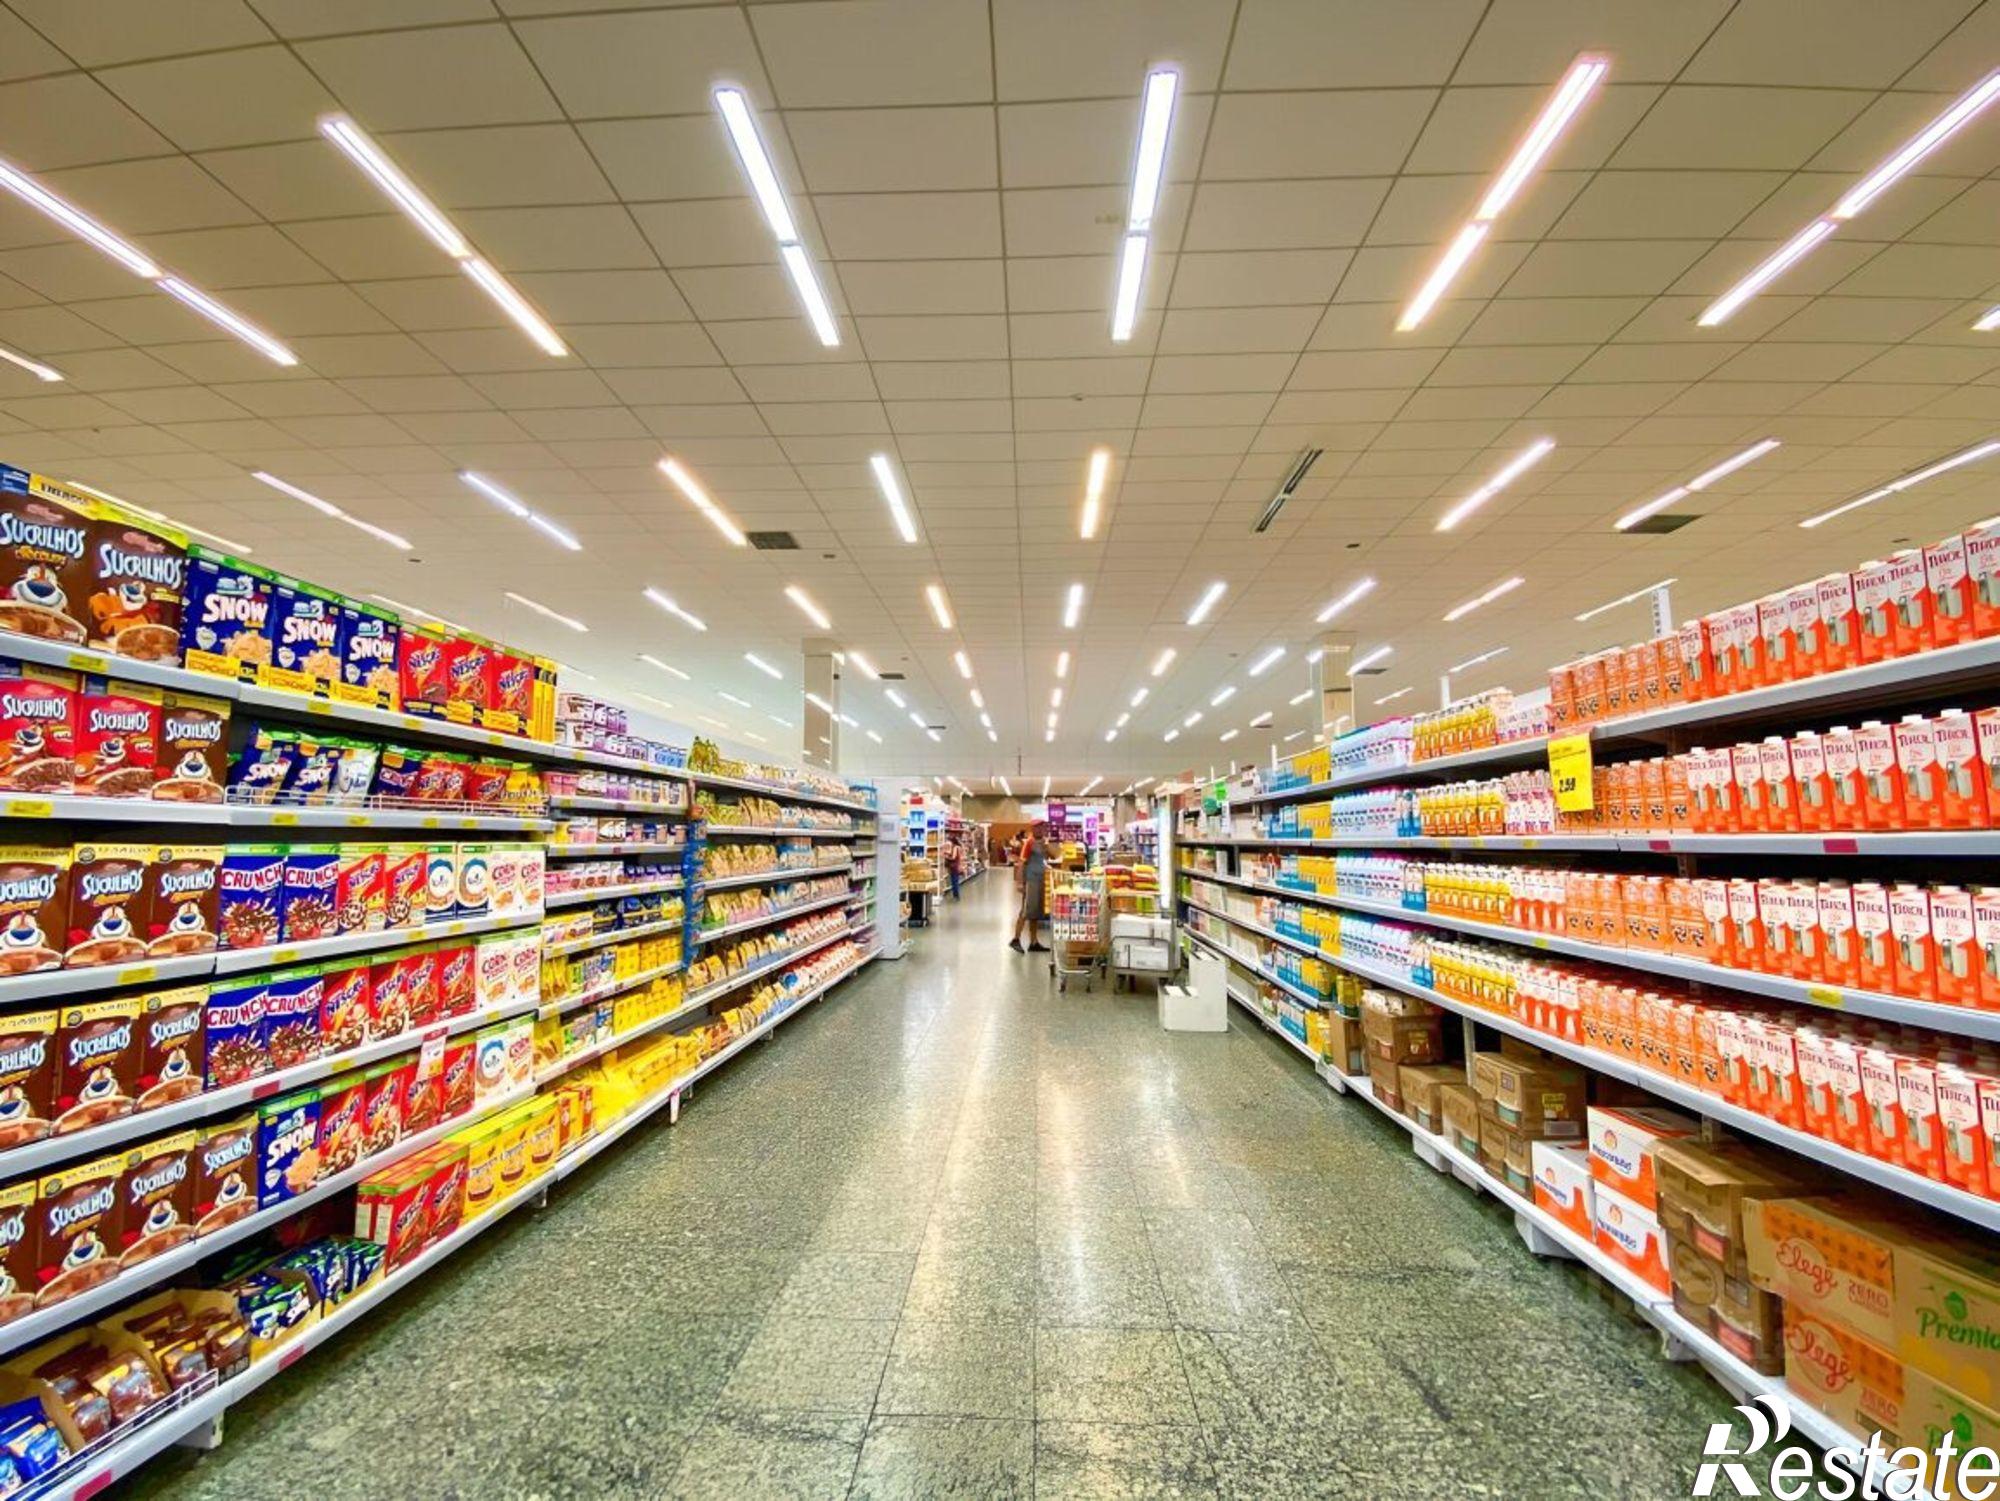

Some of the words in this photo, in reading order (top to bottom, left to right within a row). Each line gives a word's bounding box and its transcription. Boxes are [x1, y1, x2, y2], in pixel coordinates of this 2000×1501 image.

[0, 512, 86, 559] SUCRILHOS
[99, 543, 183, 590] SUCRILHOS
[202, 594, 268, 623] SNOW
[282, 616, 337, 644] SNOW
[350, 635, 395, 661] SNOW
[2, 693, 67, 720] SUCRILHOS
[90, 708, 149, 733] SUCRILHOS
[166, 718, 222, 742] SUCRILHOS
[82, 868, 144, 900] SUCRILHOS
[161, 867, 215, 897] SUCRILHOS
[222, 864, 283, 888] CRUNCH
[286, 863, 338, 885] CRUNCH
[208, 992, 268, 1026] CRUNCH
[267, 983, 324, 1013] CRUNCH
[150, 1009, 201, 1047] SUCRILHOS
[69, 1024, 131, 1067] SUCRILHOS
[267, 1121, 317, 1168] SNOW
[131, 1155, 187, 1204] SUCRILHOS
[50, 1181, 115, 1236] SUCRILHOS
